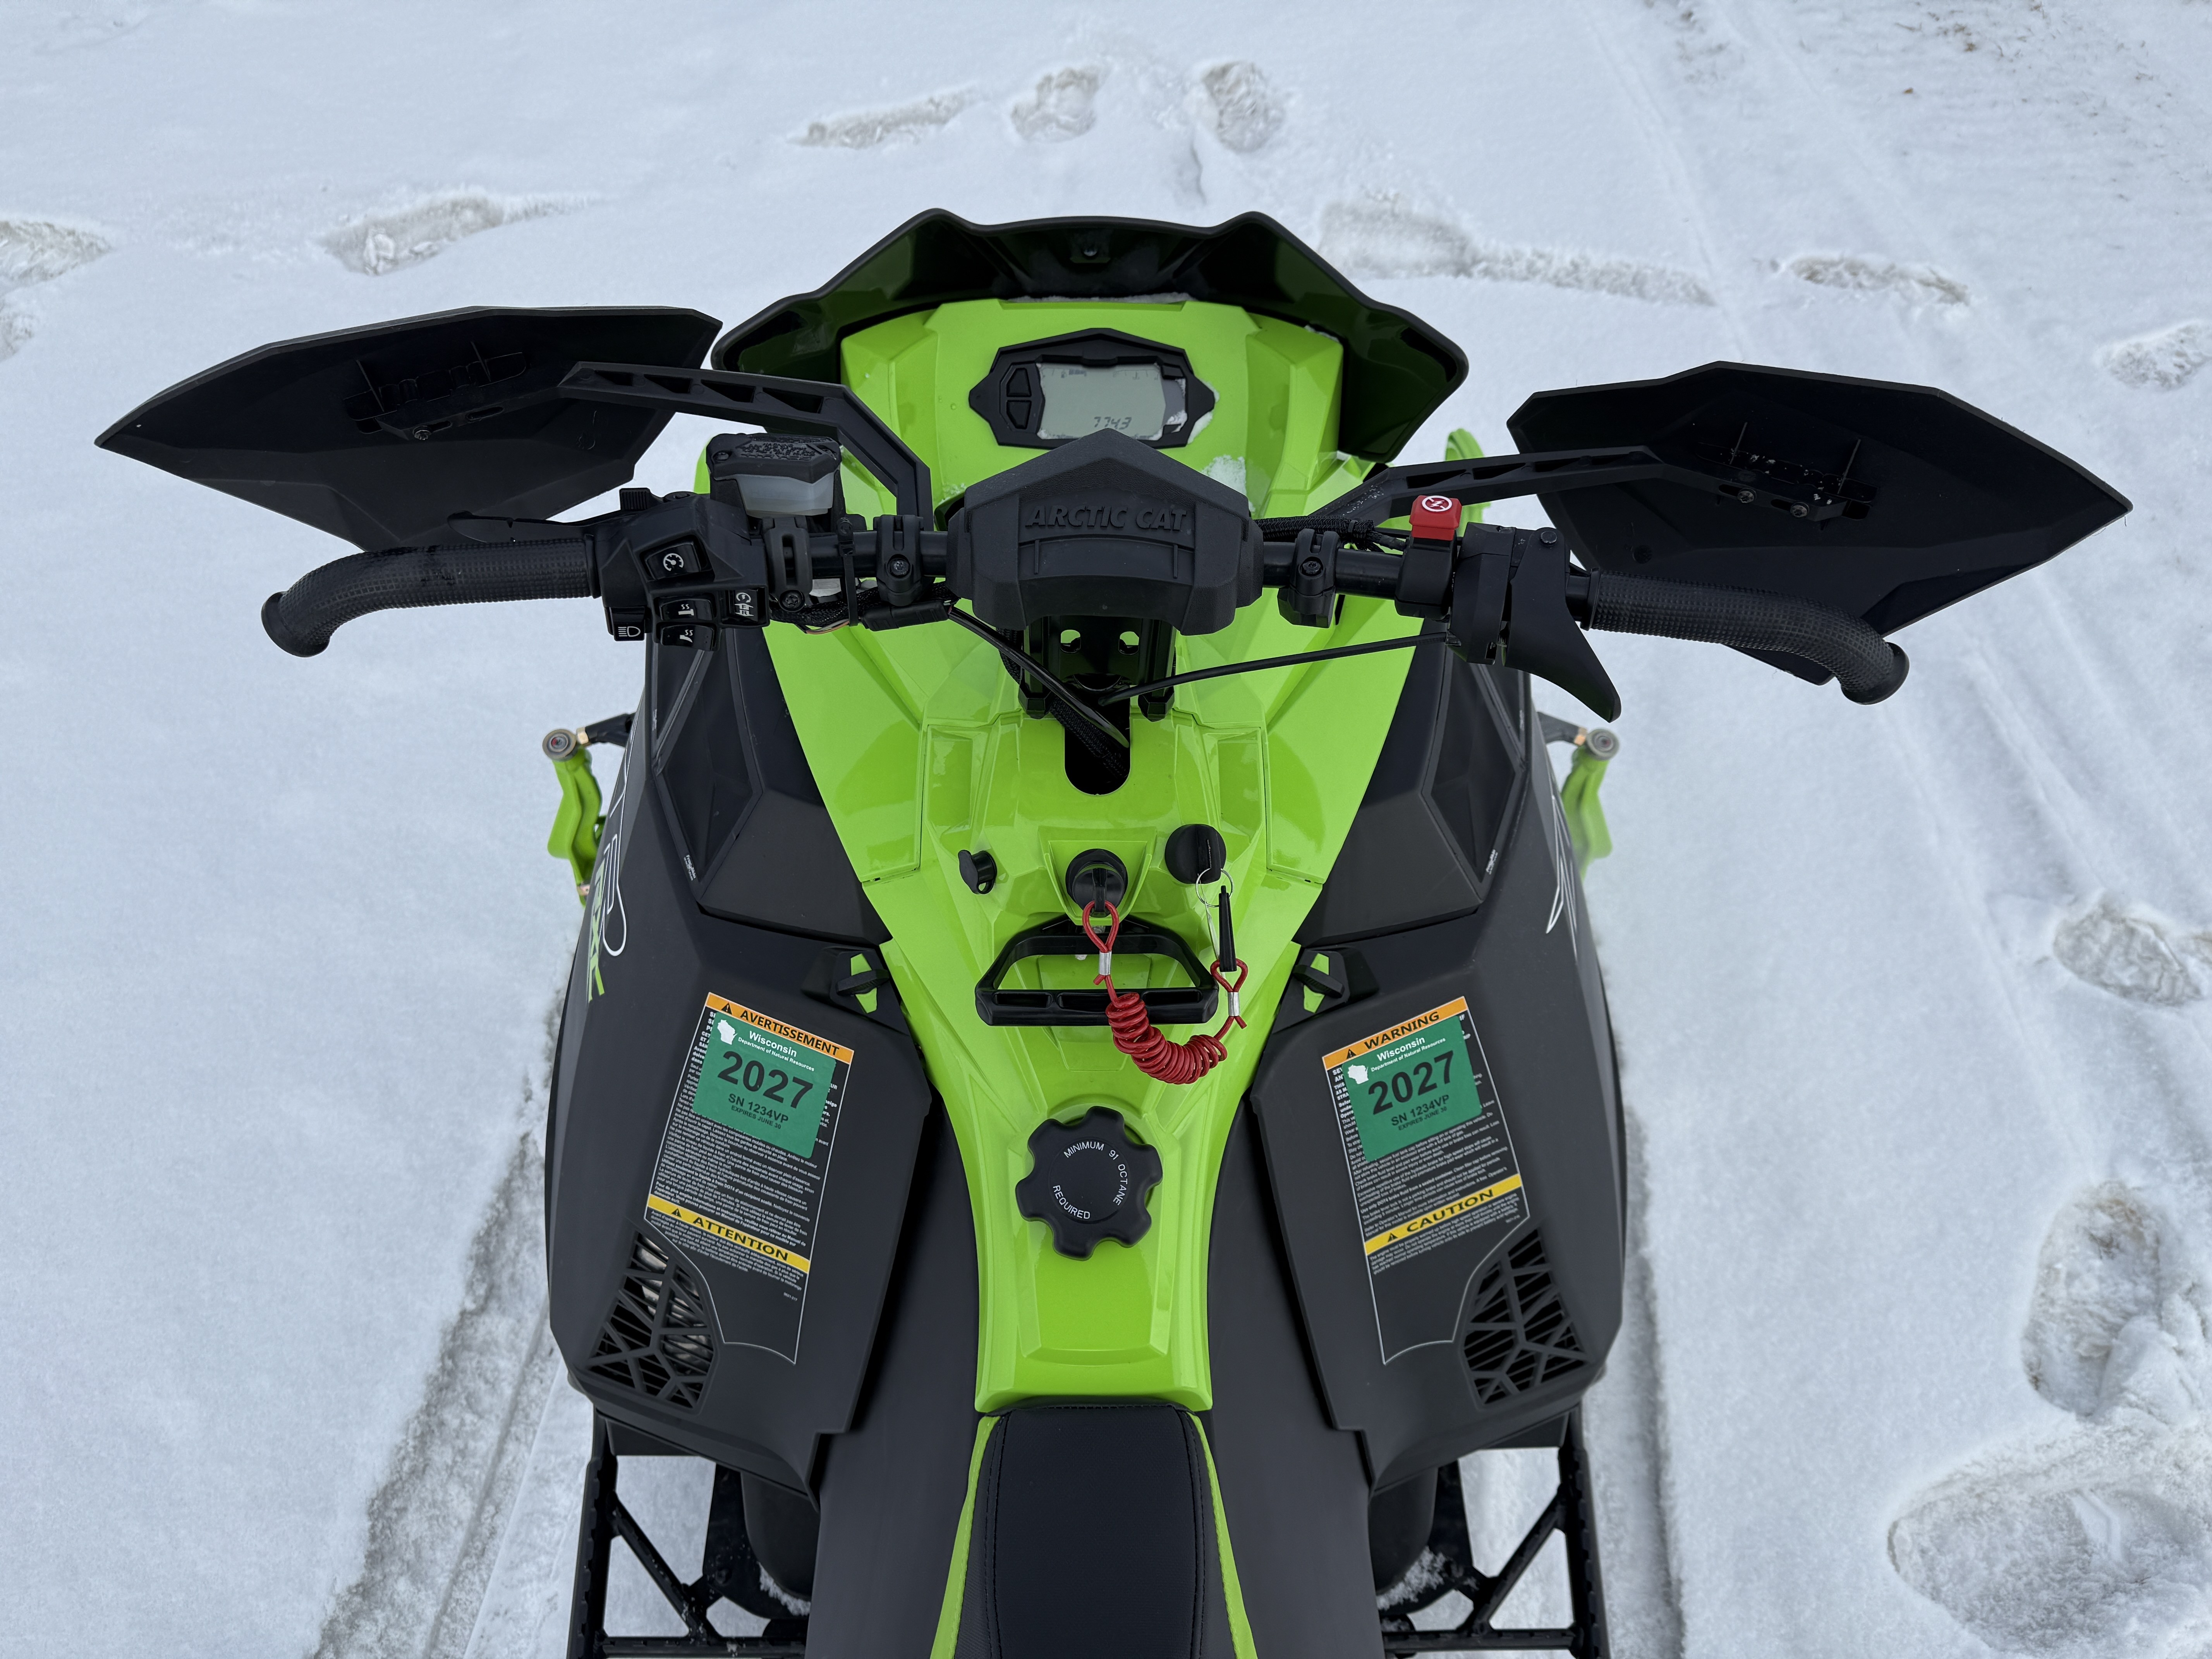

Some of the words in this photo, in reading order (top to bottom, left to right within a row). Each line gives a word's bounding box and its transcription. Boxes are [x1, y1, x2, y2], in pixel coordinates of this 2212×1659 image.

[1094, 417, 1132, 430] 7743
[1025, 505, 1128, 528] ARCTIC
[1136, 506, 1187, 531] CAT
[740, 1010, 840, 1056] AVERTISSEMENT
[749, 1030, 797, 1057] Wisconsin
[1364, 1011, 1440, 1050] WARNING
[738, 1037, 765, 1052] Department
[771, 1050, 788, 1061] Natural
[789, 1058, 815, 1072] Resources
[1370, 1057, 1398, 1073] Department
[1404, 1047, 1421, 1058] Natural
[1421, 1037, 1446, 1051] Resources
[1377, 1036, 1425, 1062] Wisconsin
[718, 1051, 813, 1109] 2027
[1368, 1050, 1453, 1115] 2027
[728, 1093, 745, 1107] SN
[748, 1101, 789, 1123] 1234VP
[731, 1105, 757, 1120] EXPIRES
[757, 1115, 774, 1127] JUNE
[1391, 1112, 1407, 1127] SN
[1410, 1094, 1449, 1117] 1234VP
[1398, 1116, 1423, 1131] EXPIRES
[1423, 1109, 1439, 1120] JUNE
[1064, 1141, 1104, 1158] MINIMUM
[1109, 1150, 1118, 1160] 91
[1113, 1164, 1128, 1205] OCTANE
[1053, 1185, 1090, 1219] REQUIRED
[1407, 1190, 1492, 1233] CAUTION
[692, 1216, 788, 1261] ATTENTION
